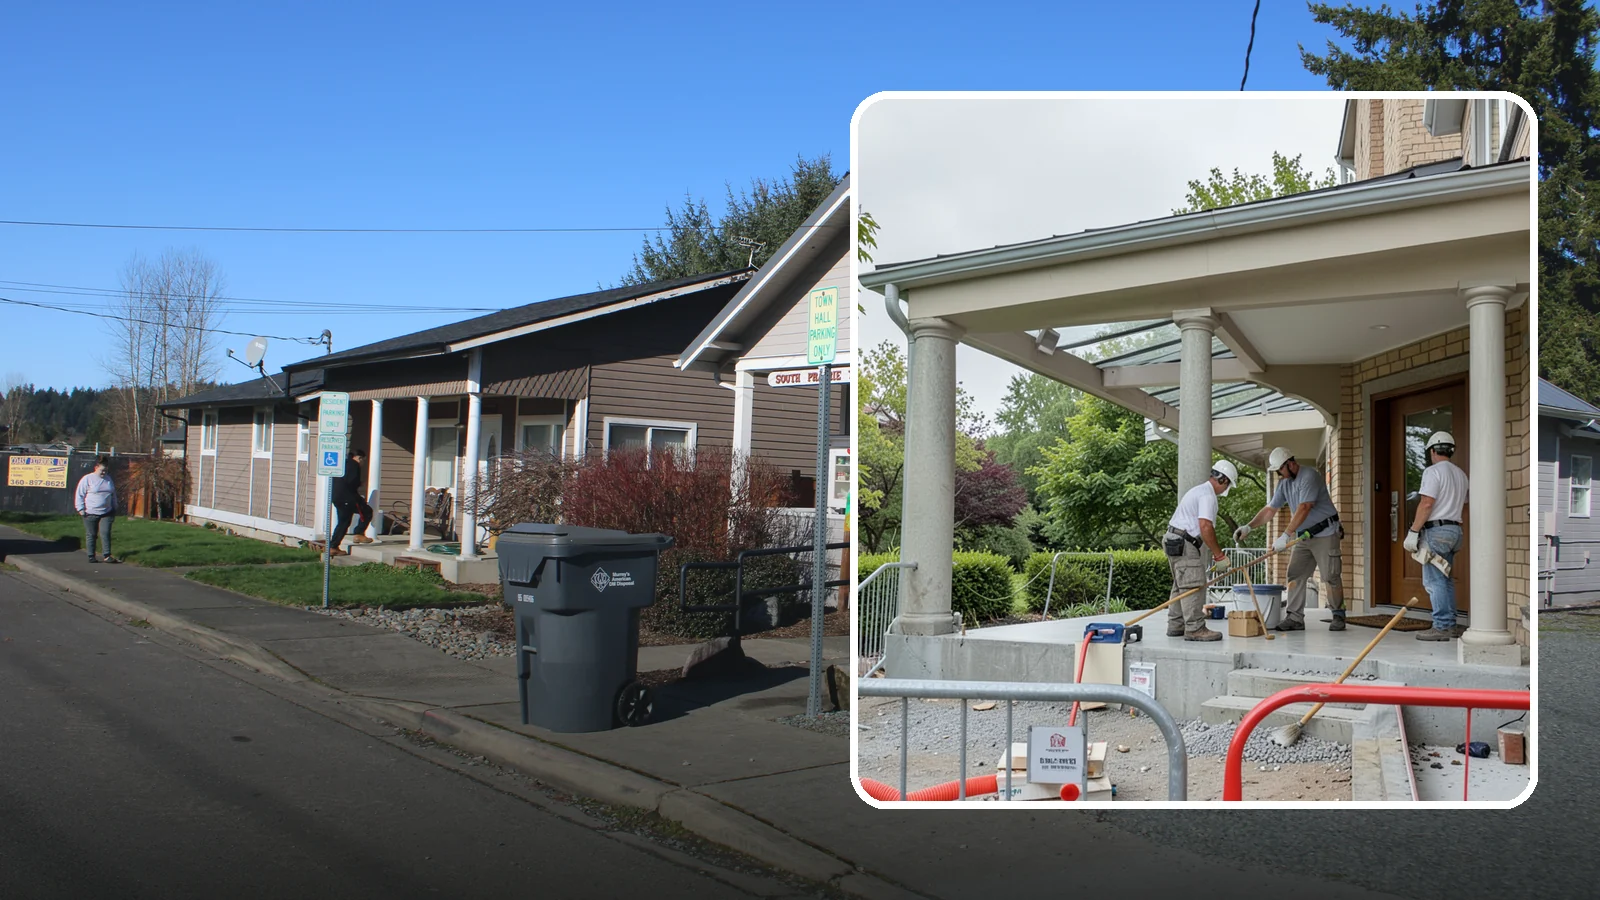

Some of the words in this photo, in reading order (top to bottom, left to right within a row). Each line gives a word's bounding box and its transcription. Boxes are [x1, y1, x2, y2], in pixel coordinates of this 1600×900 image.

[815, 295, 832, 307] TOWN
[814, 312, 831, 324] HALL
[810, 327, 835, 340] PARKING
[813, 344, 830, 357] ONLY
[775, 374, 800, 384] SOUTH
[807, 370, 842, 383] PRIE
